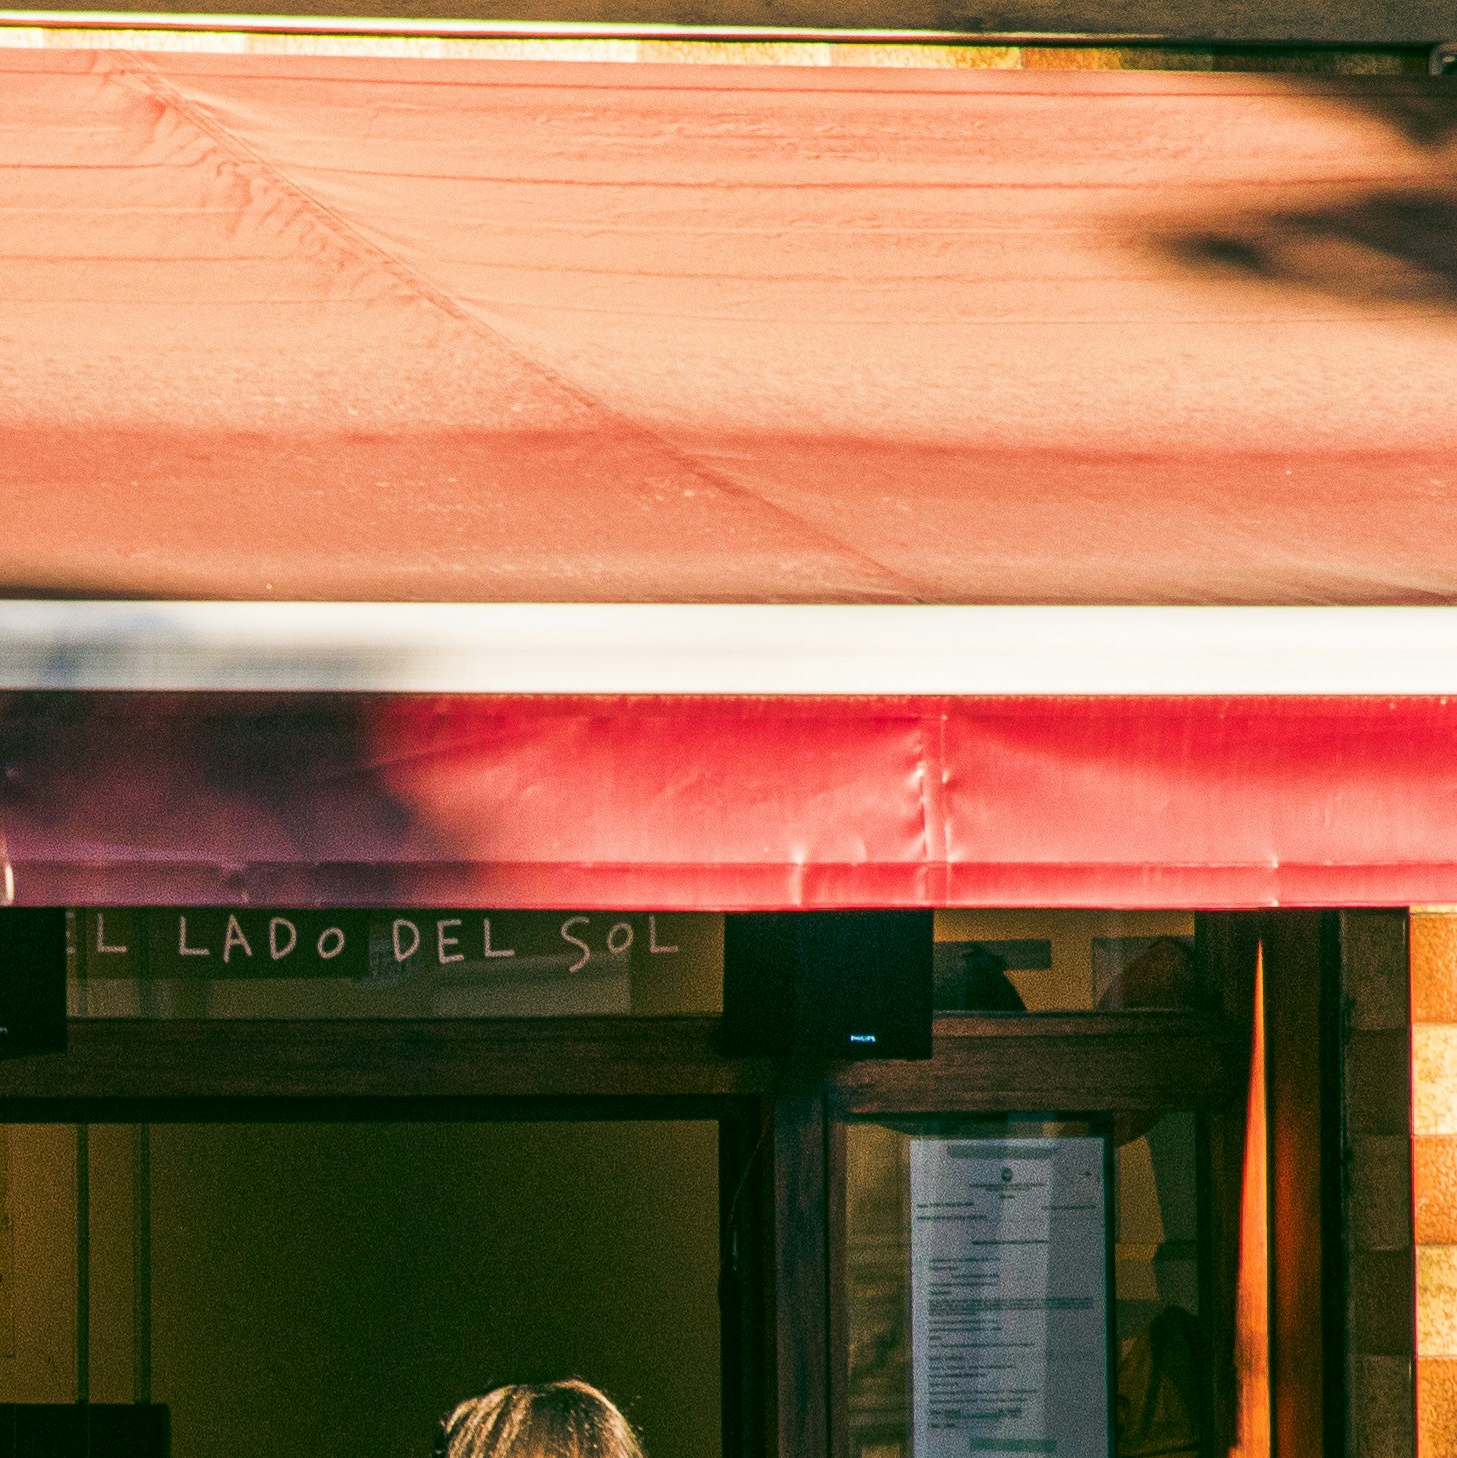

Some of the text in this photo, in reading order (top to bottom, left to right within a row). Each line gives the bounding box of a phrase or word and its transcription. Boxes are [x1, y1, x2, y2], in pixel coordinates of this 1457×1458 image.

[65, 911, 679, 973] L LADO DEL SOL
